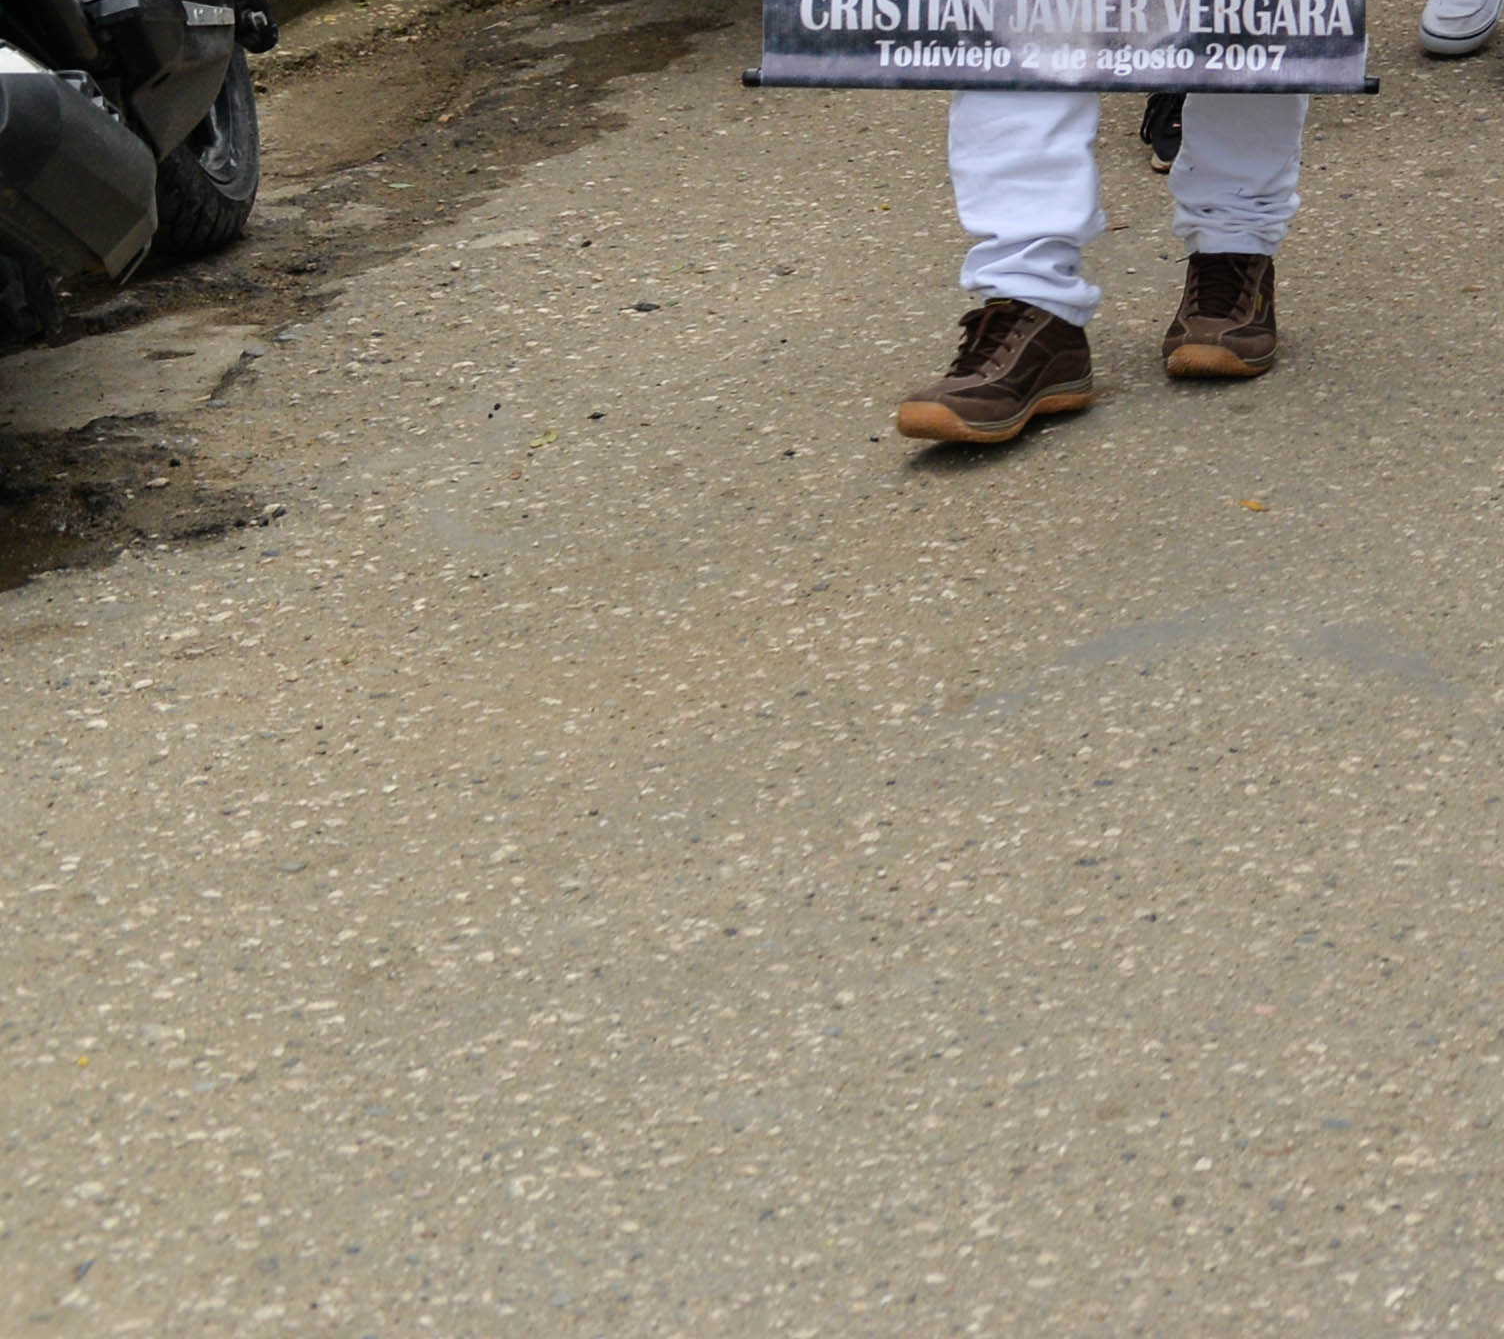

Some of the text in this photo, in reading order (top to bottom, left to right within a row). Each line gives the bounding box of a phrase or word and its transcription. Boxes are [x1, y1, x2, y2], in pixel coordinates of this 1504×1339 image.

[874, 39, 1288, 77] Tolúviejo 2 de agosto 2007
